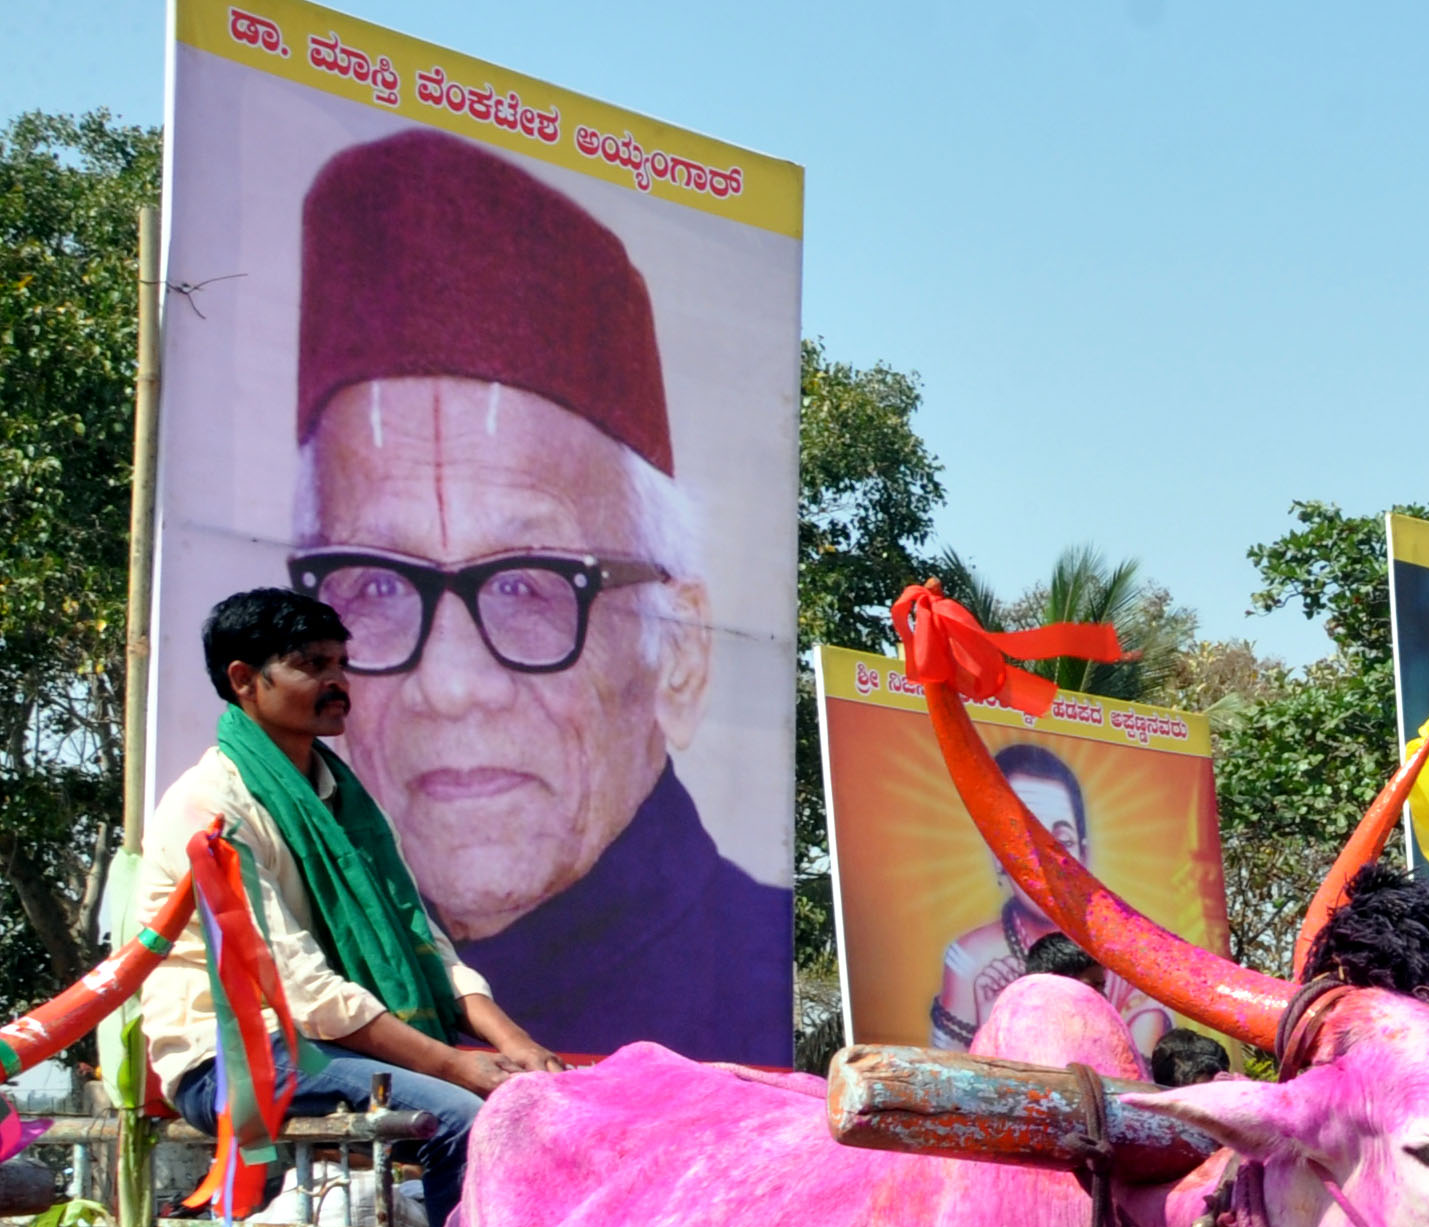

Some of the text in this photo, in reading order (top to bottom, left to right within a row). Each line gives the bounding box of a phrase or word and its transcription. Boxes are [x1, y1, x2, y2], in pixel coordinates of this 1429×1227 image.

[228, 6, 743, 198] ಡಾ. ಮಾಸ್ತಿ ವೆಂಕಟೇಶ ಅಯ್ಯಂಗಾರ್
[856, 662, 879, 694] ಶ್ರೀ
[1053, 695, 1103, 726] ಹಡಪದ
[1110, 709, 1188, 744] ಅಪ್ಪಣ್ಣನವರು
